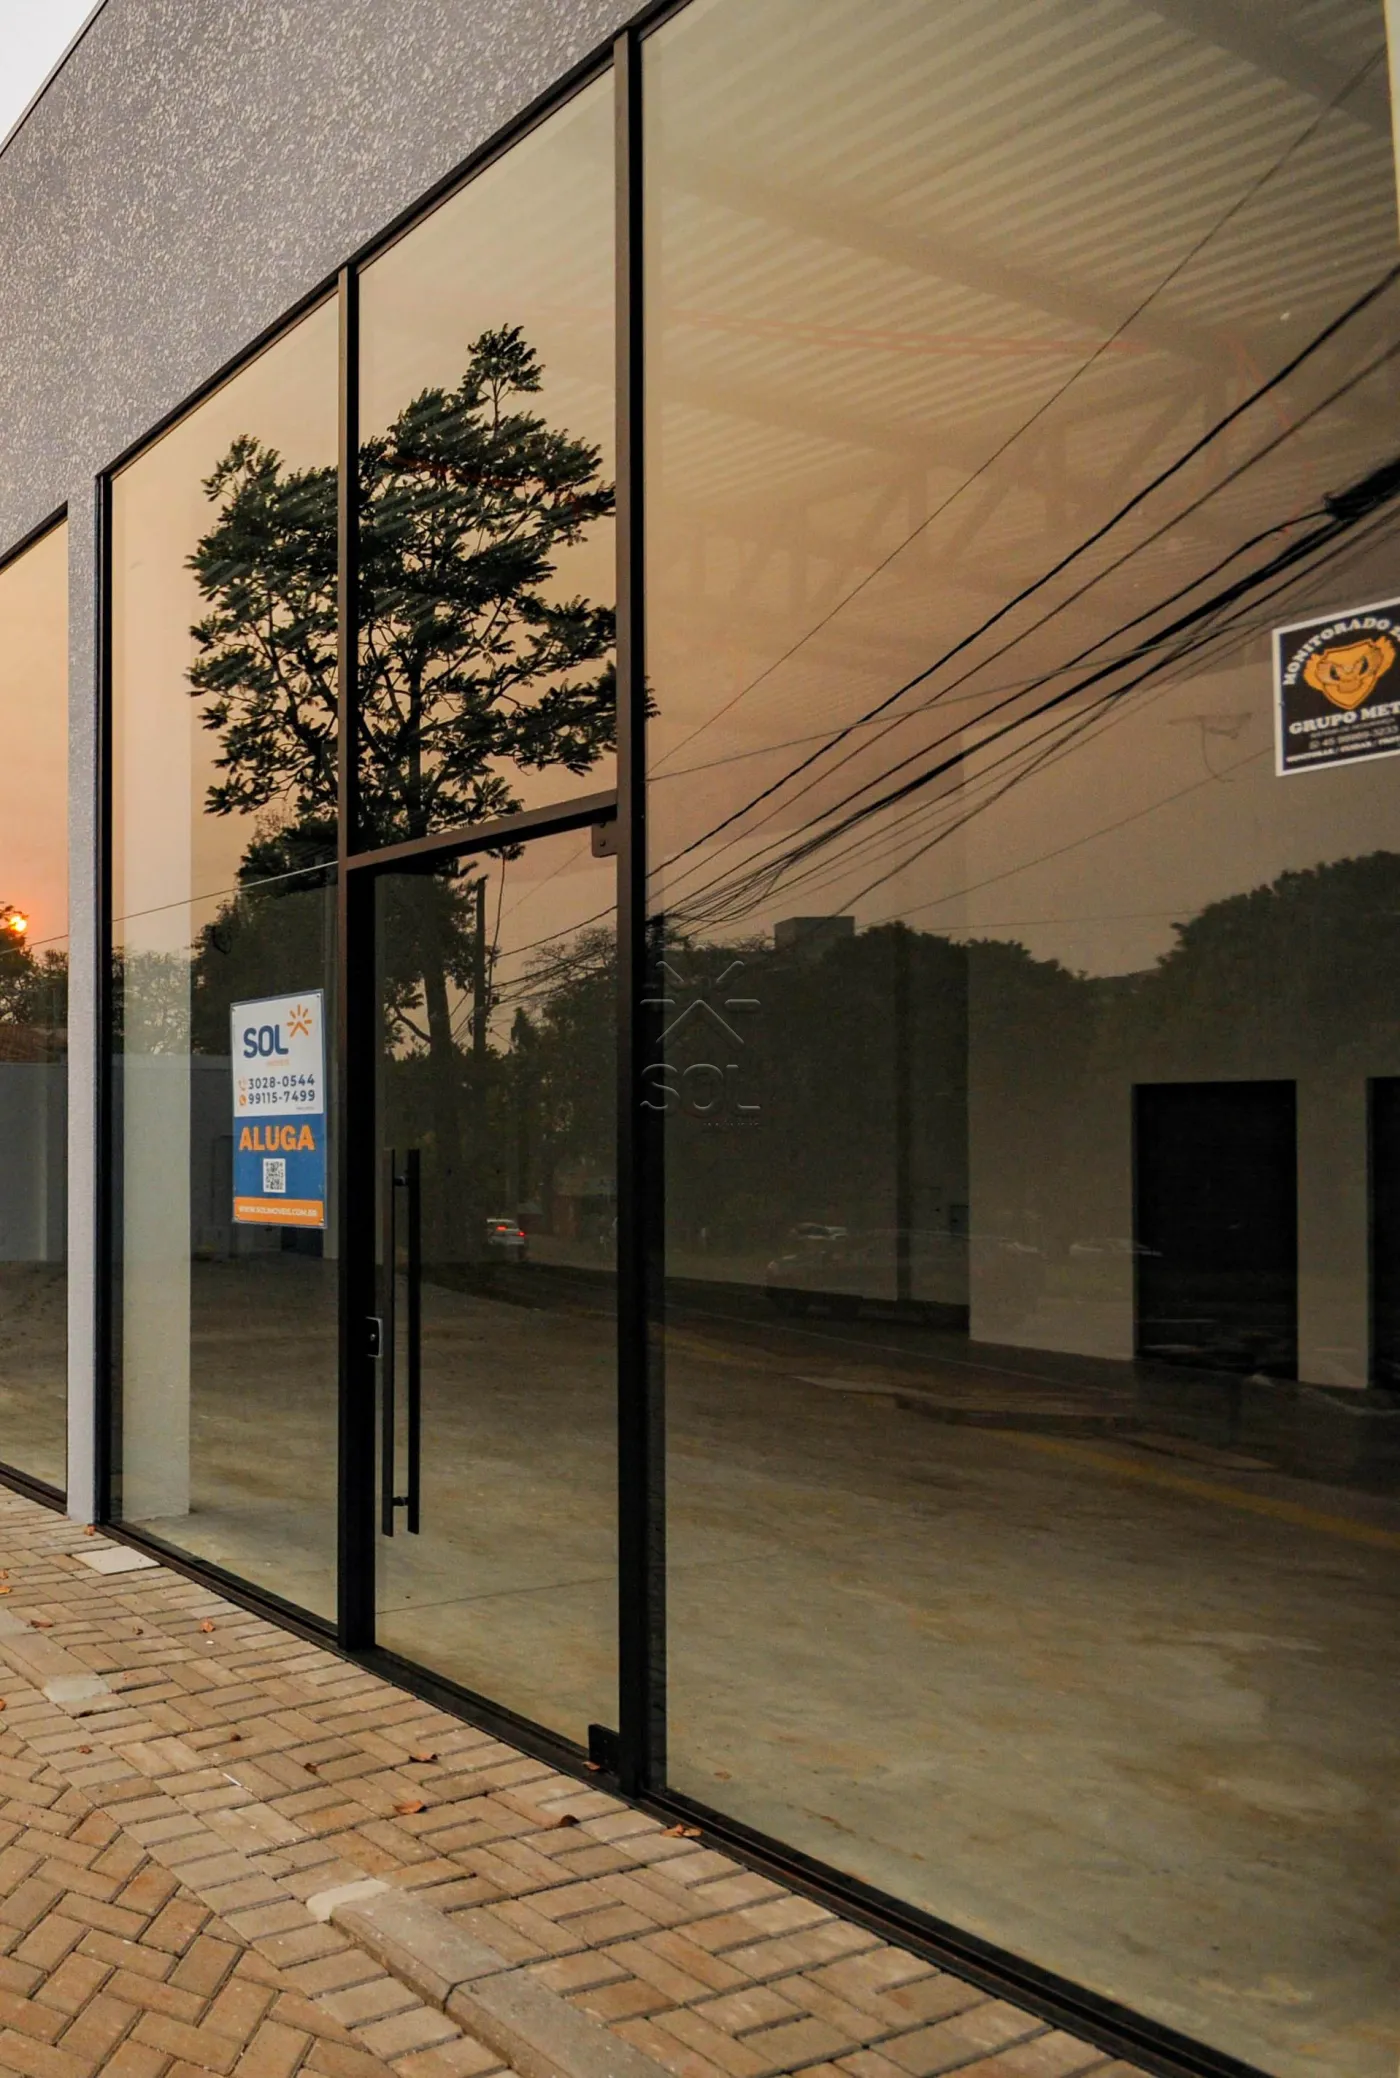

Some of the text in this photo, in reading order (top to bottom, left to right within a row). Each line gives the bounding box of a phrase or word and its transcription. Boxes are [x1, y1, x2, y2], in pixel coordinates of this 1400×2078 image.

[1282, 617, 1391, 686] MONITORADO
[1289, 711, 1357, 735] GRUPO
[243, 1024, 289, 1059] SOL
[248, 1073, 315, 1090] 3028-0544
[248, 1089, 315, 1105] 99115-7499
[238, 1124, 316, 1151] ALUGA
